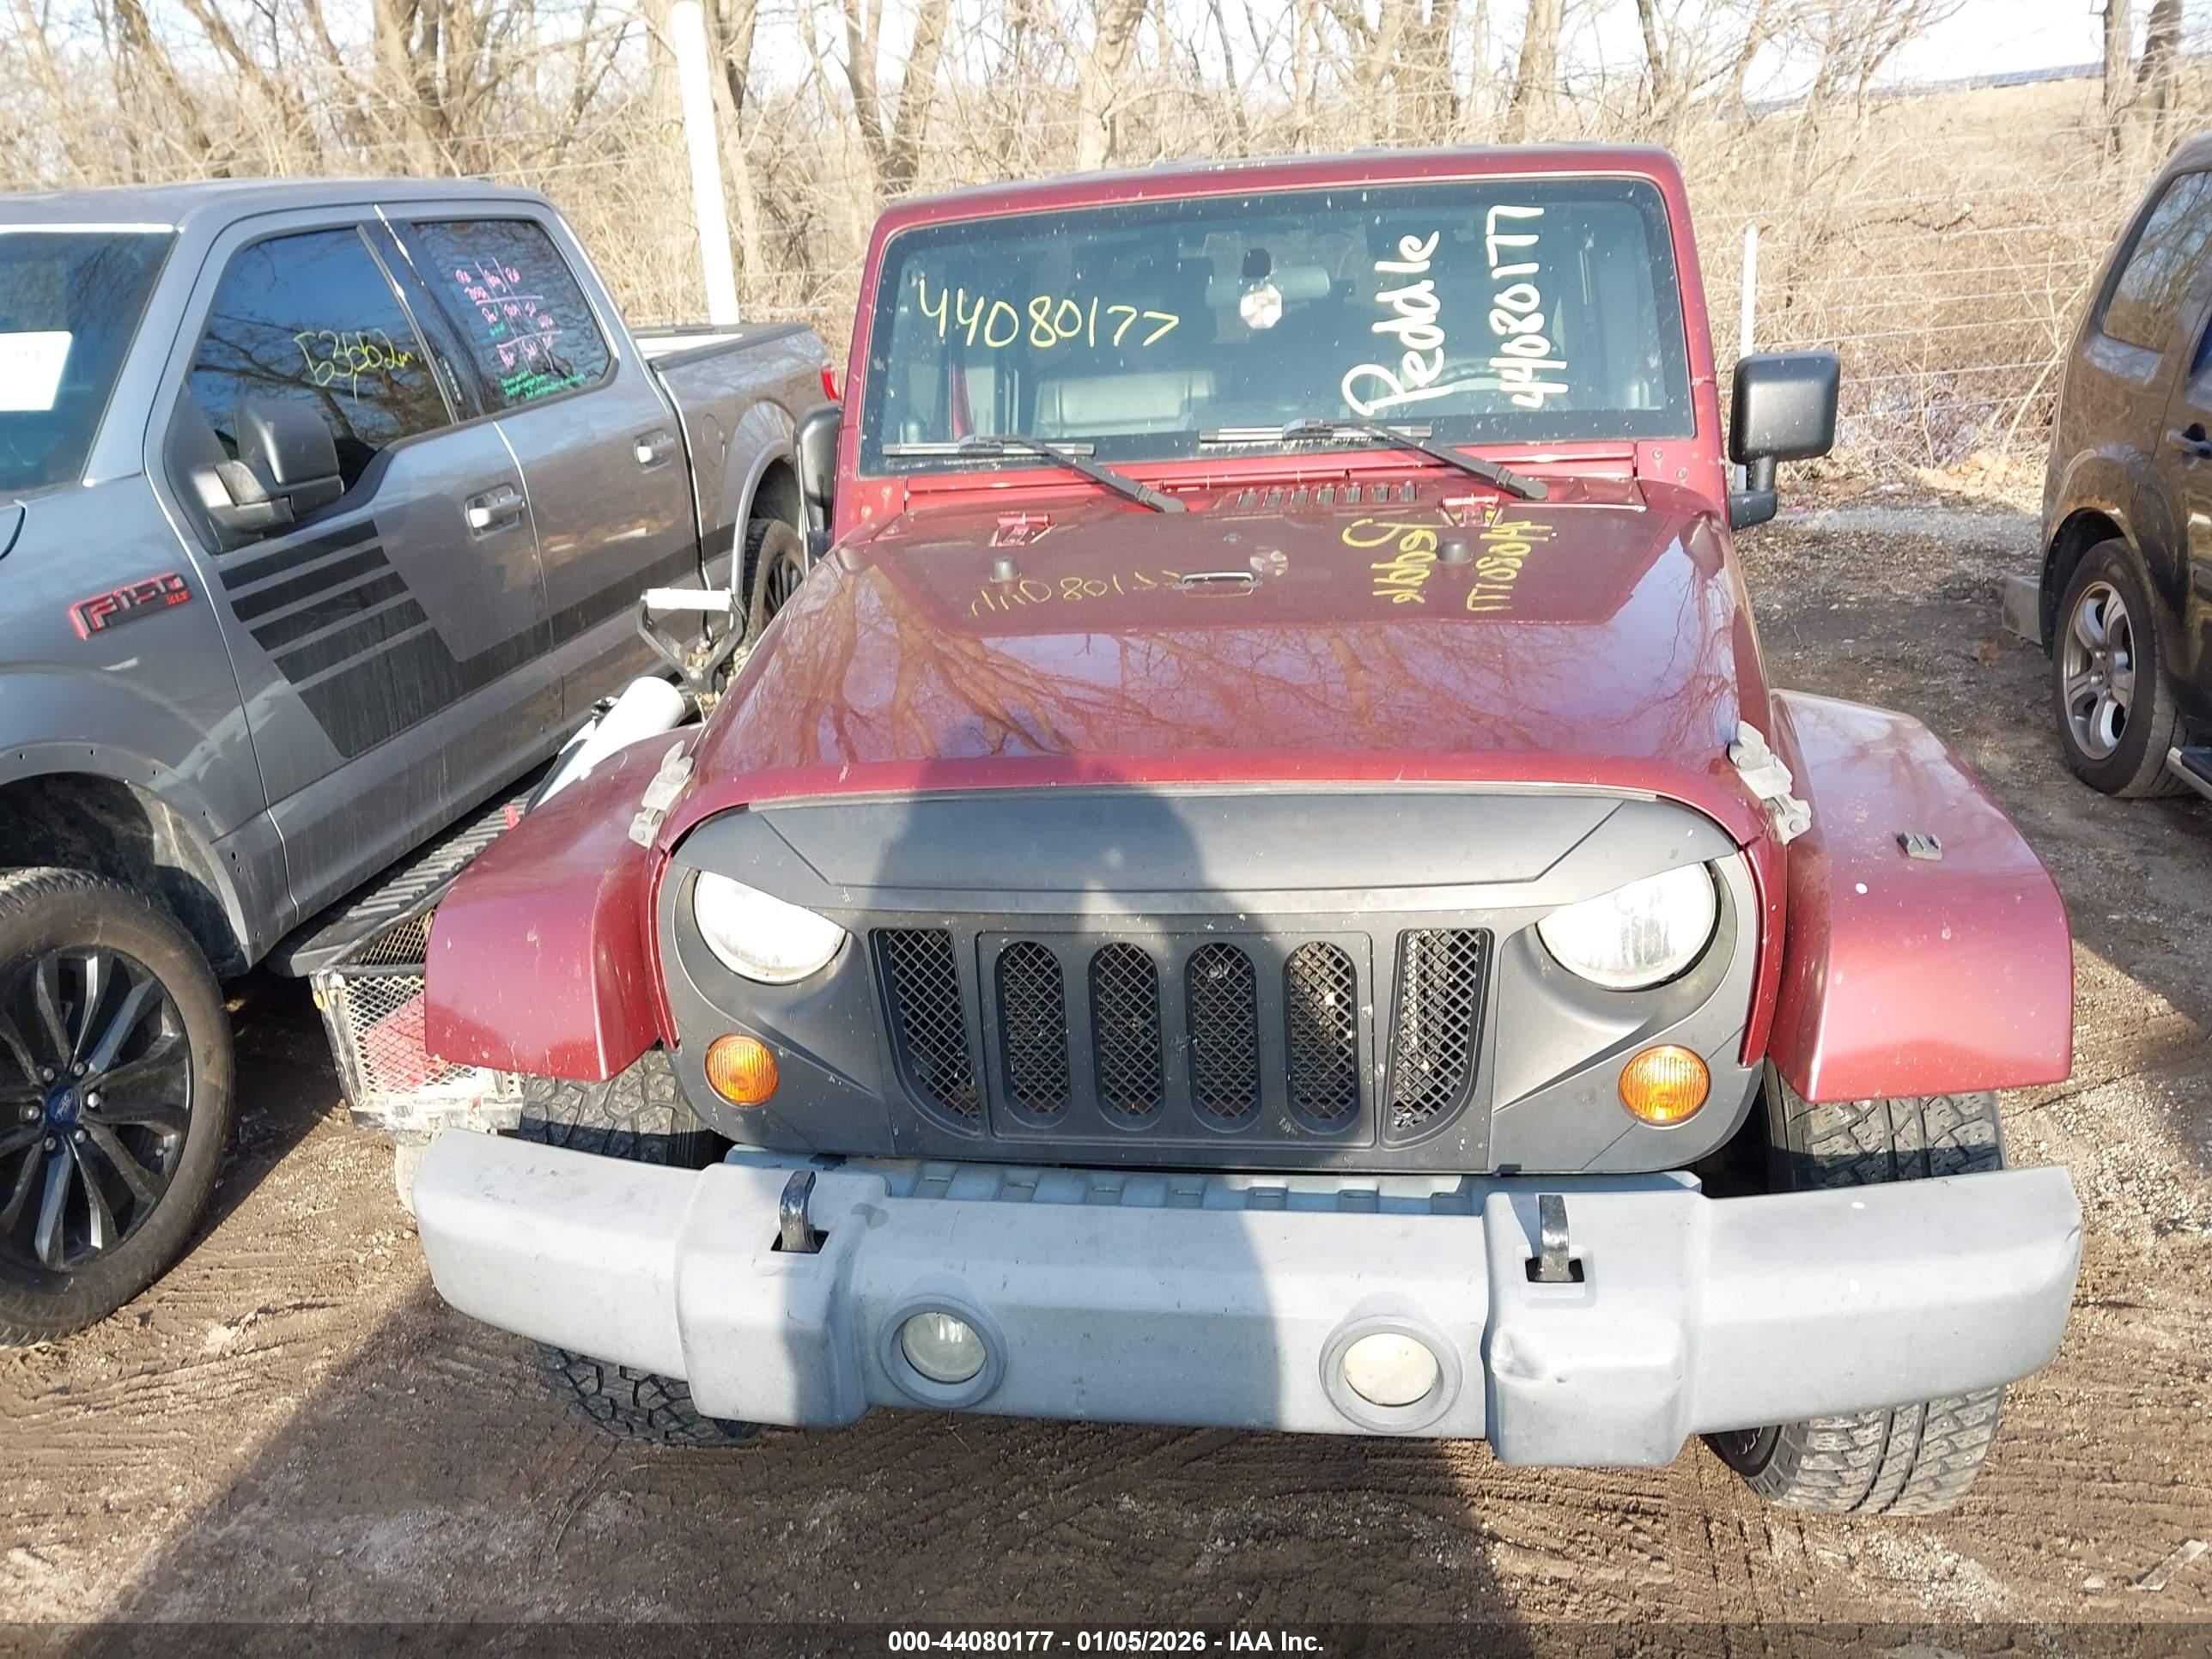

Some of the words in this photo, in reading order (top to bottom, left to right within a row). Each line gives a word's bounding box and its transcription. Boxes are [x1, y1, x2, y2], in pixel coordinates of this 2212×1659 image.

[920, 278, 1180, 348] 44080177
[1341, 230, 1454, 416] Peddle
[1486, 205, 1569, 408] 44080177
